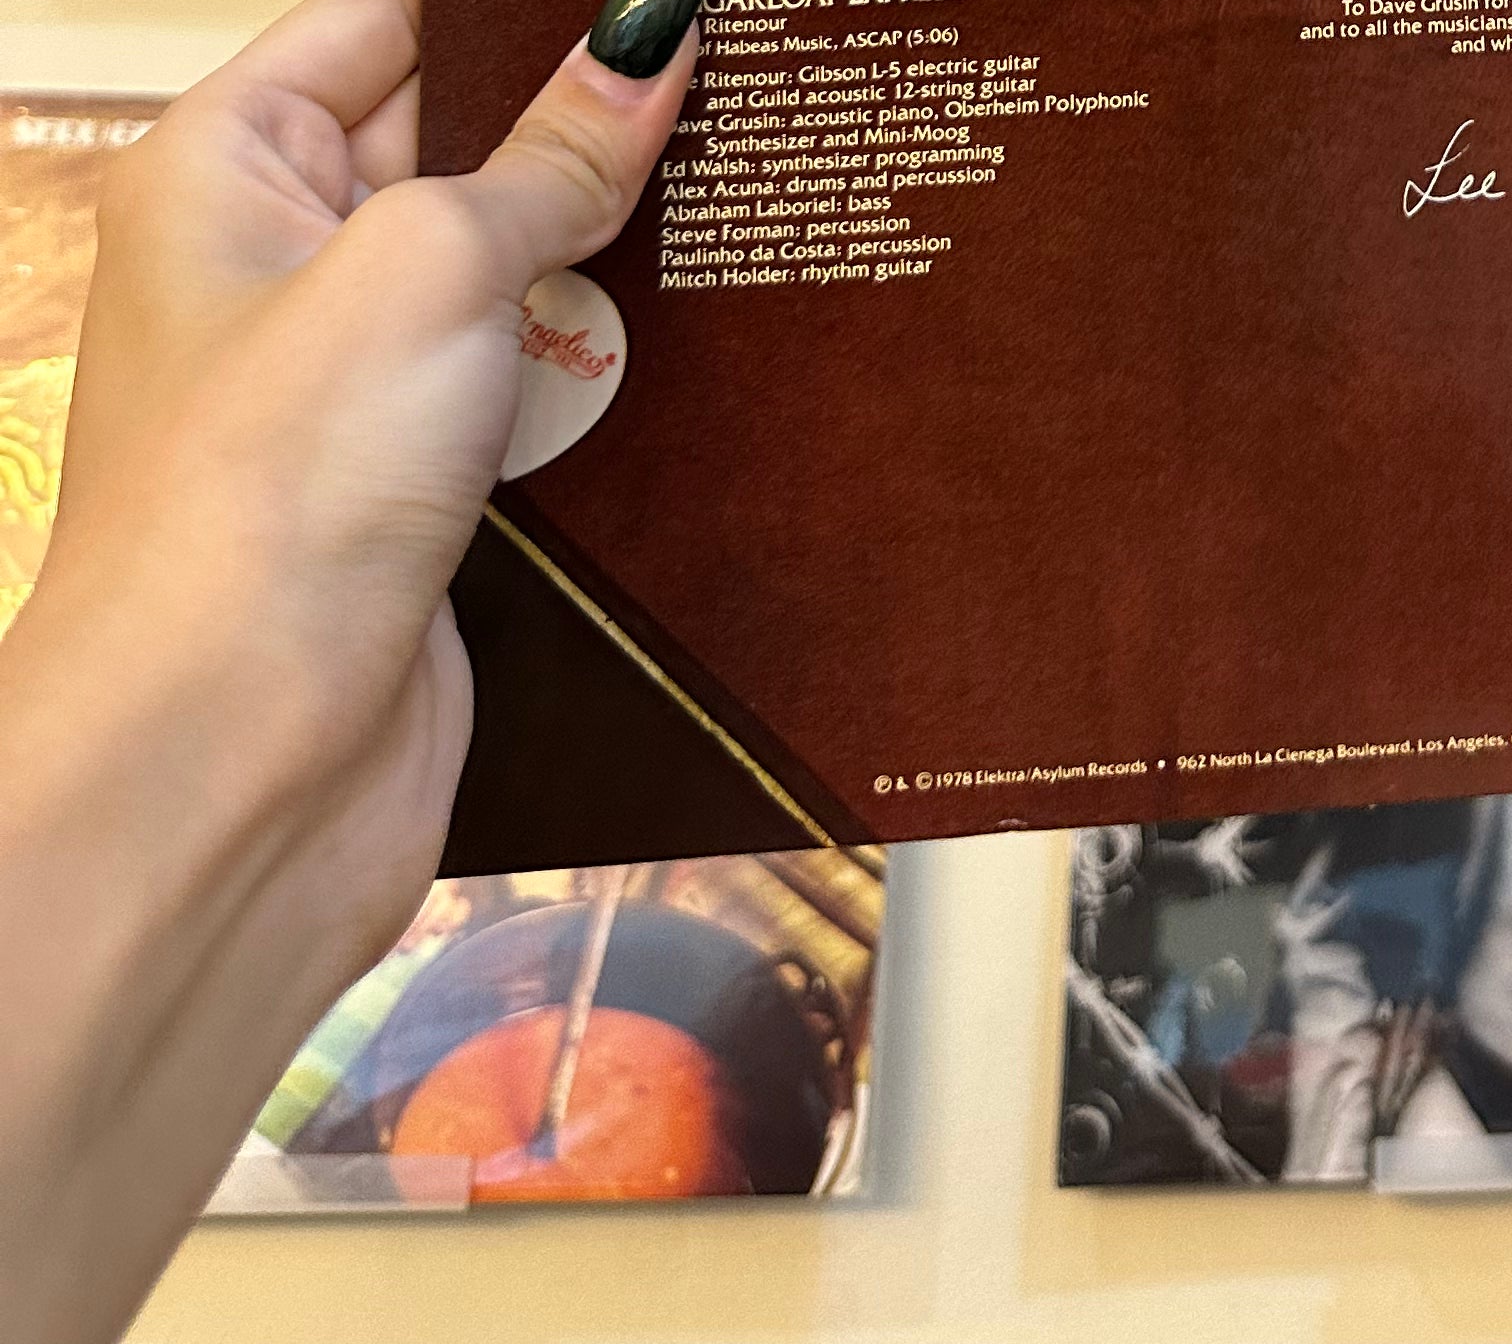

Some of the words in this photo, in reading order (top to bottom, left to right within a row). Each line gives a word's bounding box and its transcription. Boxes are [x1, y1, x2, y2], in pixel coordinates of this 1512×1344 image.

[704, 14, 788, 34] Ritenour
[1404, 120, 1506, 218] Lee
[660, 269, 717, 289] Mitch
[722, 265, 796, 286] Holder:
[800, 261, 870, 286] rhythm
[874, 258, 933, 283] guitar
[1176, 754, 1207, 770] 962
[1210, 751, 1253, 768] North
[1254, 750, 1273, 766] La
[1274, 747, 1335, 764] Cienega
[1336, 739, 1415, 759] Boulevard,
[1417, 738, 1444, 754] Los
[1446, 733, 1509, 753] Angeles,
[975, 765, 1086, 785] Elektra/Asylum
[1087, 759, 1148, 777] Records
